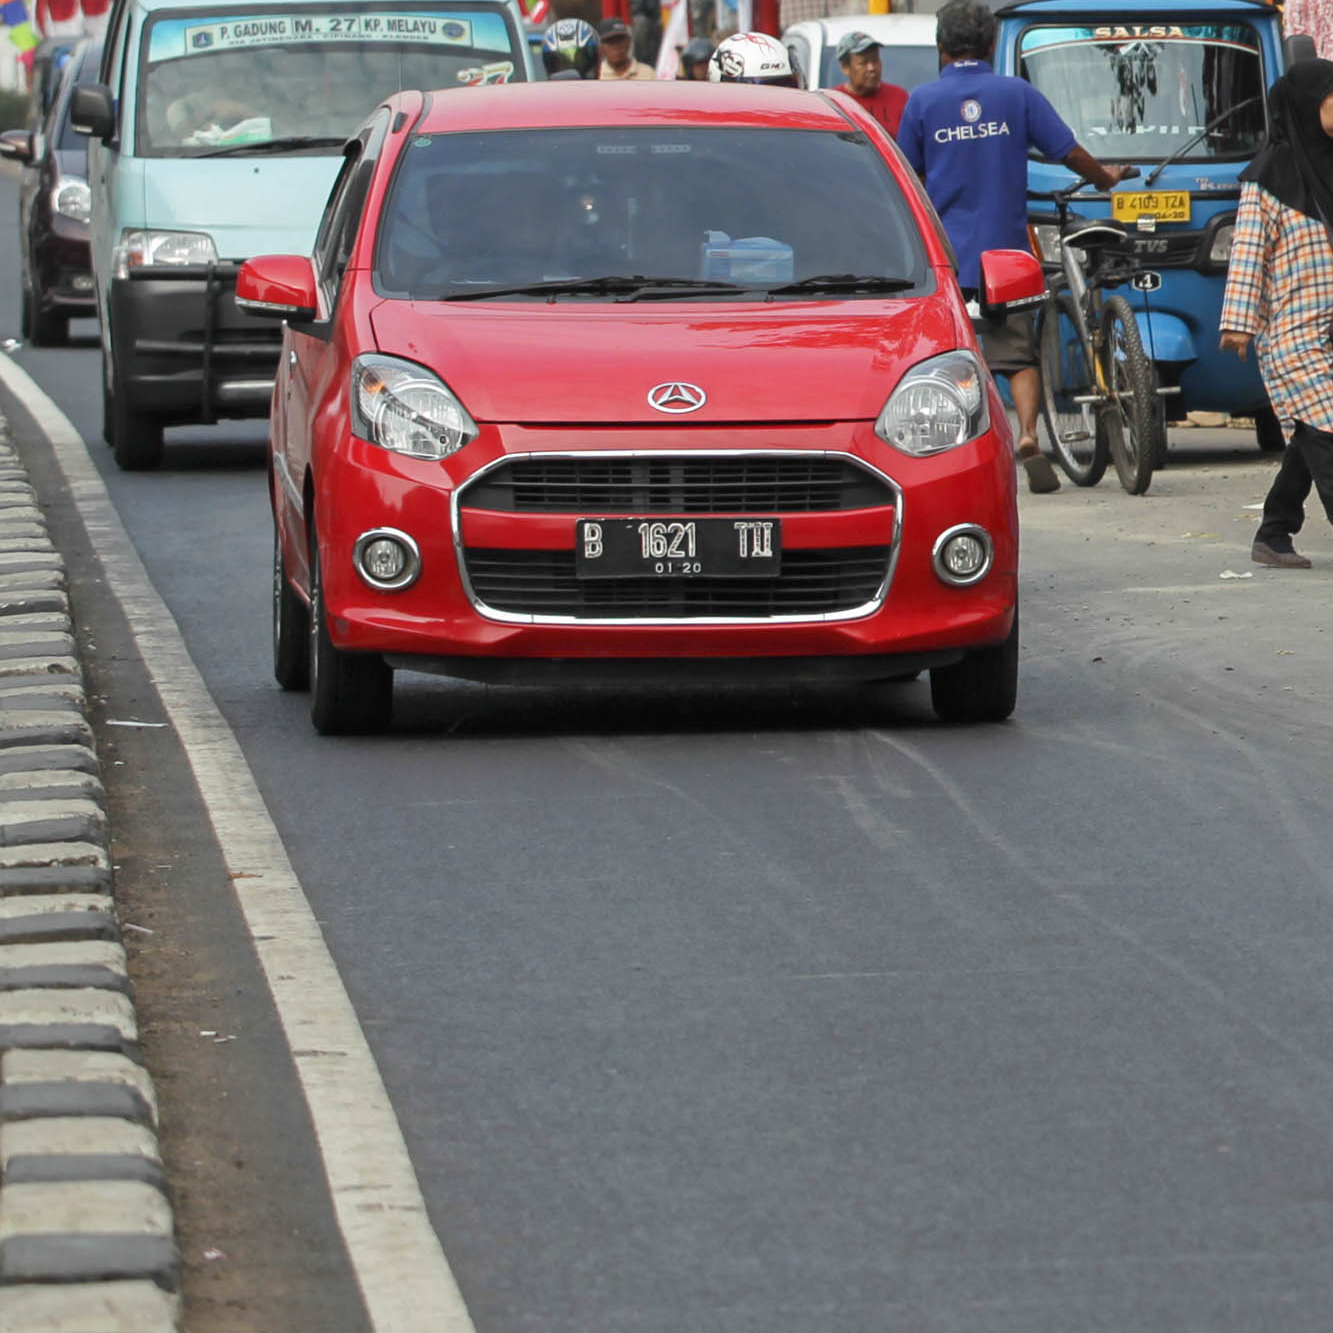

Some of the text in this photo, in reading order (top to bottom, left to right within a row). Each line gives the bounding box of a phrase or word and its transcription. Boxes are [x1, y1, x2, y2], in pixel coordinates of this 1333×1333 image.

[233, 21, 287, 38] GADUNG
[329, 18, 356, 33] 27
[364, 18, 437, 34] KP. MELAYU
[1094, 26, 1185, 39] SALSA
[934, 121, 1010, 144] CHELSEA
[1116, 197, 1125, 210] B
[1164, 195, 1185, 208] TZA
[1133, 239, 1169, 253] TVS
[584, 522, 603, 559] B
[638, 521, 696, 559] 1621
